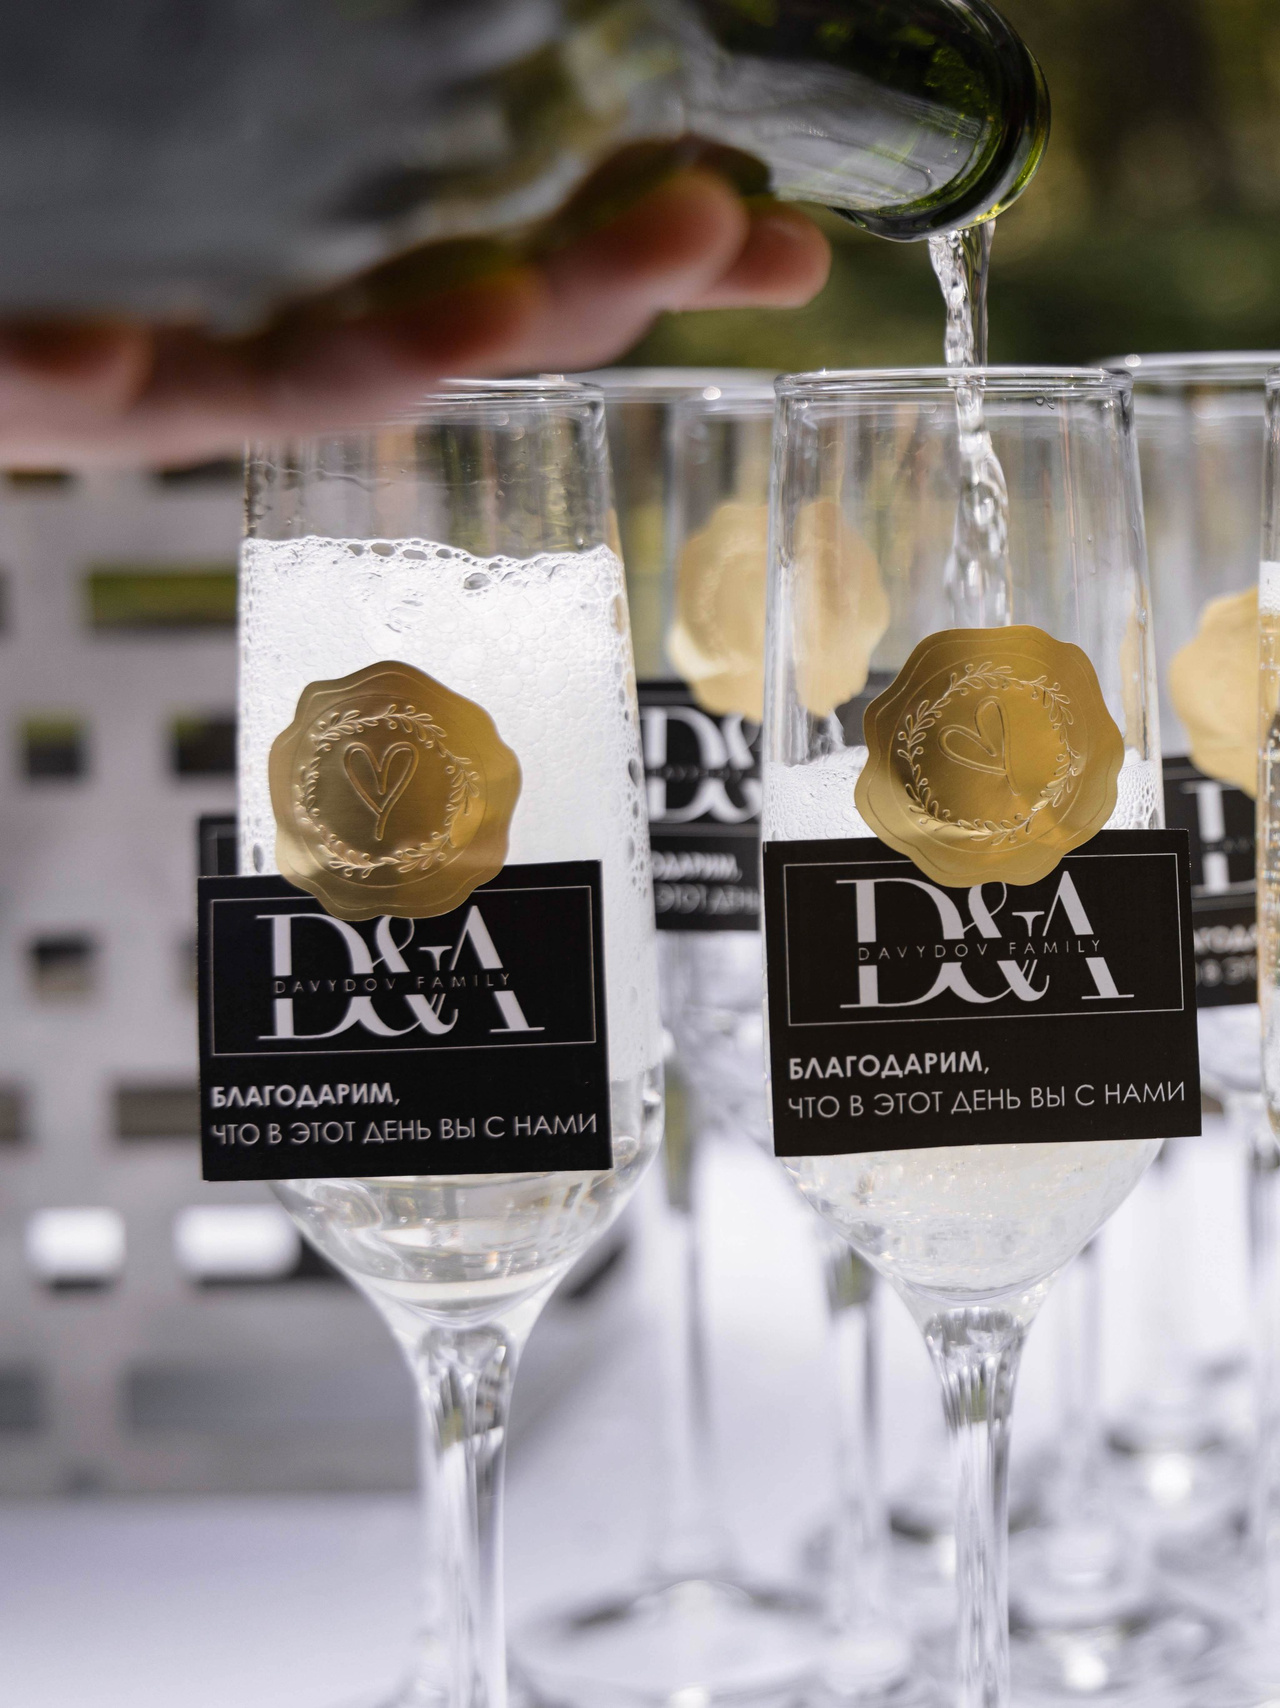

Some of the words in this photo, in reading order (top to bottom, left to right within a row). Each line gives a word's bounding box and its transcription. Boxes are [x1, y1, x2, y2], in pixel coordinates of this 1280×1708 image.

[858, 943, 988, 961] DAVYDOV
[1009, 939, 1101, 955] FAMILY
[274, 978, 397, 995] DAVYDOV
[417, 973, 510, 988] FAMILY
[789, 1050, 989, 1079] БЛАГОДАРИМ,
[212, 1082, 400, 1108] БЛАГОДАРИМ,
[788, 1096, 840, 1118] ЧТО
[851, 1095, 863, 1116] В
[874, 1092, 943, 1115] ЭТОТ
[950, 1088, 1021, 1114] ДЕНЬ
[1031, 1086, 1065, 1107] ВЫ
[1075, 1084, 1095, 1106] С
[1105, 1081, 1185, 1104] НАМИ
[212, 1124, 259, 1145] ЧТО
[269, 1123, 282, 1143] В
[291, 1120, 355, 1143] ЭТОТ
[364, 1119, 431, 1143] ДЕНЬ
[441, 1117, 475, 1139] ВЫ
[485, 1116, 505, 1137] С
[515, 1113, 597, 1136] НАМИ
